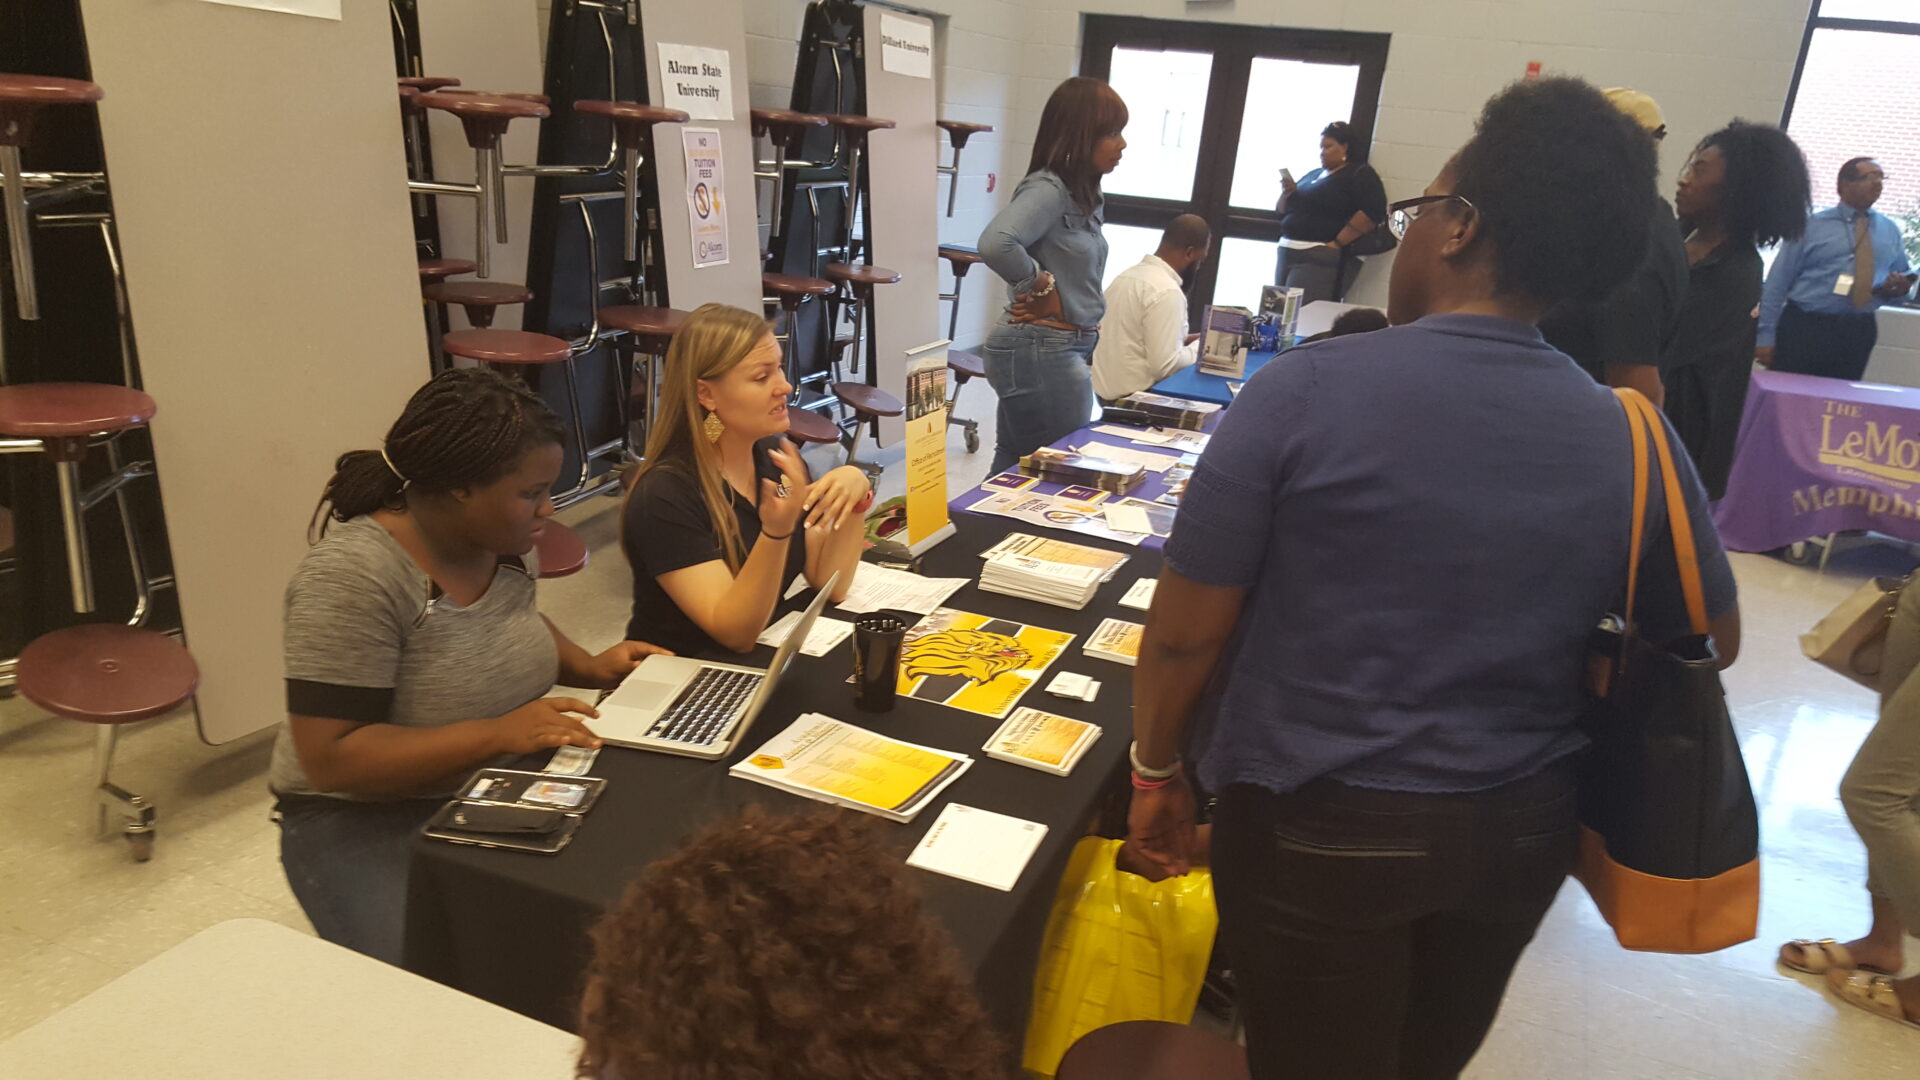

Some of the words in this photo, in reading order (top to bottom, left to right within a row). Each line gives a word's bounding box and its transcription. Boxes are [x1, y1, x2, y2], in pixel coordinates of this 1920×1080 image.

[903, 40, 929, 56] University
[668, 60, 698, 75] Alcorn
[702, 63, 722, 78] State
[677, 82, 720, 101] University
[694, 158, 716, 168] TUITION
[699, 169, 712, 178] FEES
[1824, 400, 1862, 417] THE
[1819, 414, 1920, 469] LeMo
